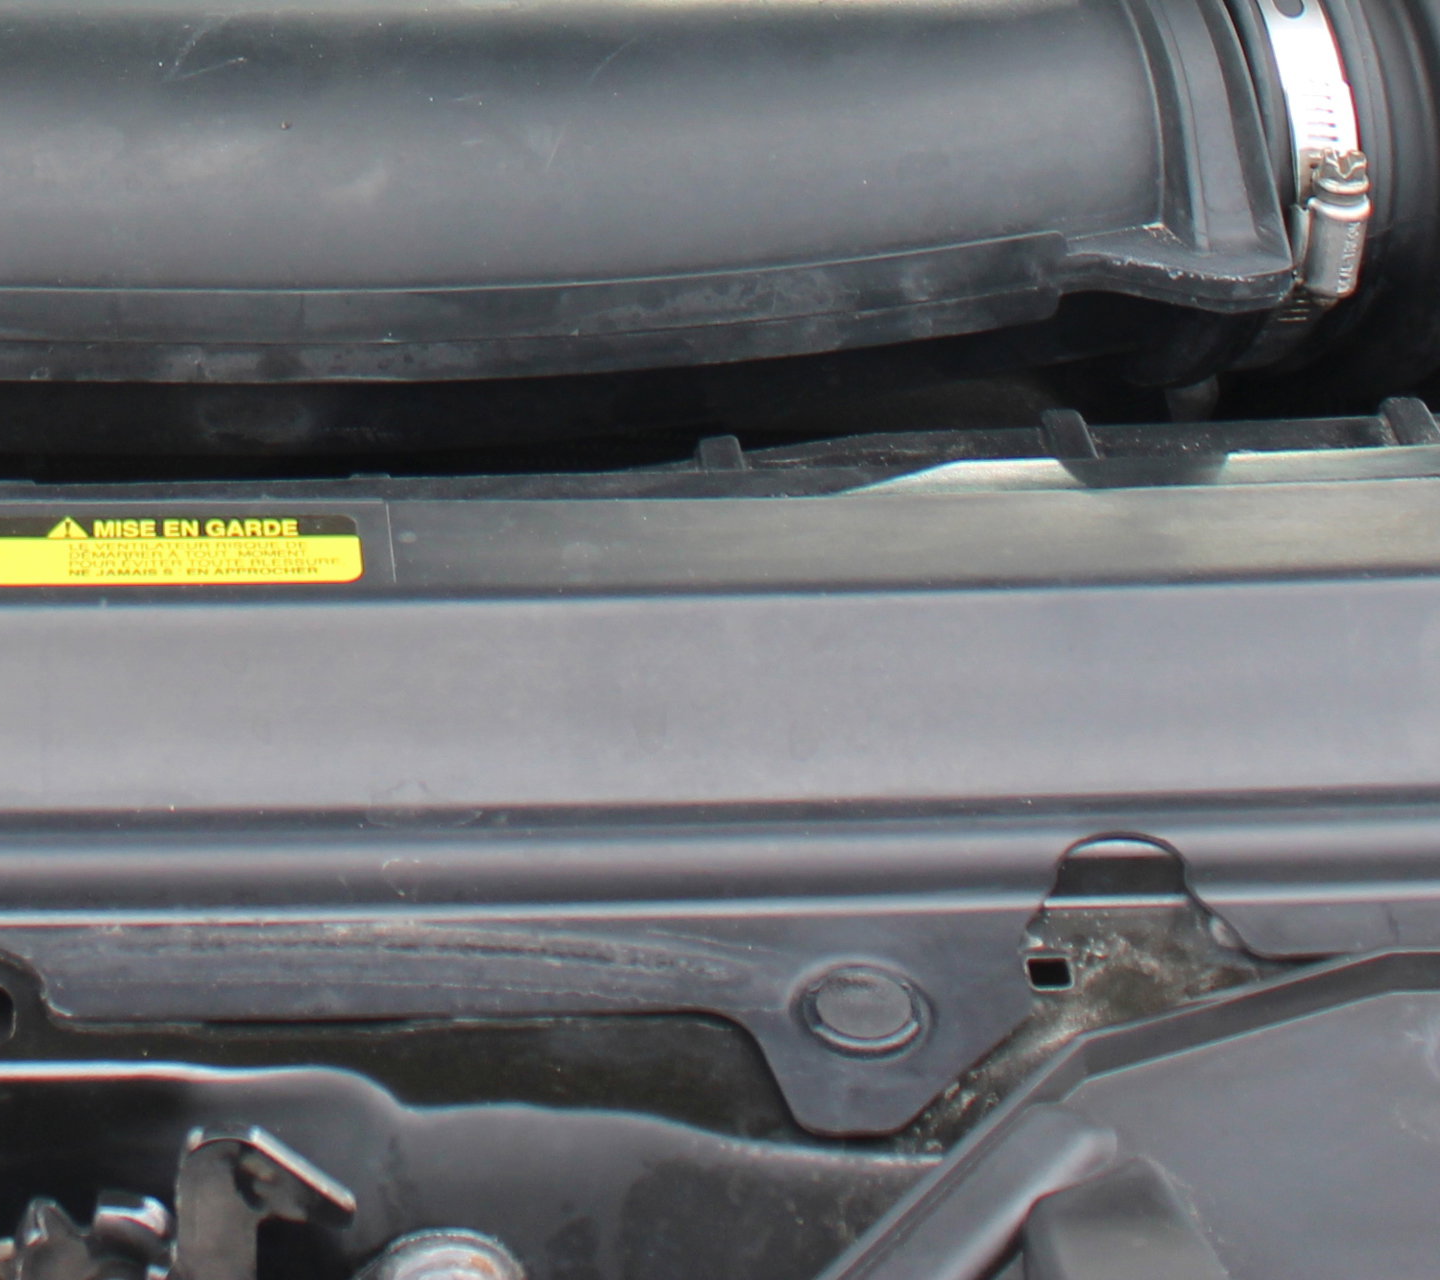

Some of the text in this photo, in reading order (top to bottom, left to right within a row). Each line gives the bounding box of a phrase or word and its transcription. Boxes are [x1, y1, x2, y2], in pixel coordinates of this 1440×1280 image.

[93, 518, 299, 538] MISE EN GARDE
[69, 541, 308, 551] LE VENTILATEUR RISQUE DE
[184, 550, 227, 559] TOUT
[237, 550, 306, 558] MOMENT
[69, 559, 113, 568] POUR
[185, 558, 236, 567] TOUTE
[69, 569, 90, 577] NE
[96, 568, 159, 577] JAMAIS
[214, 566, 319, 575] APPROCHER
